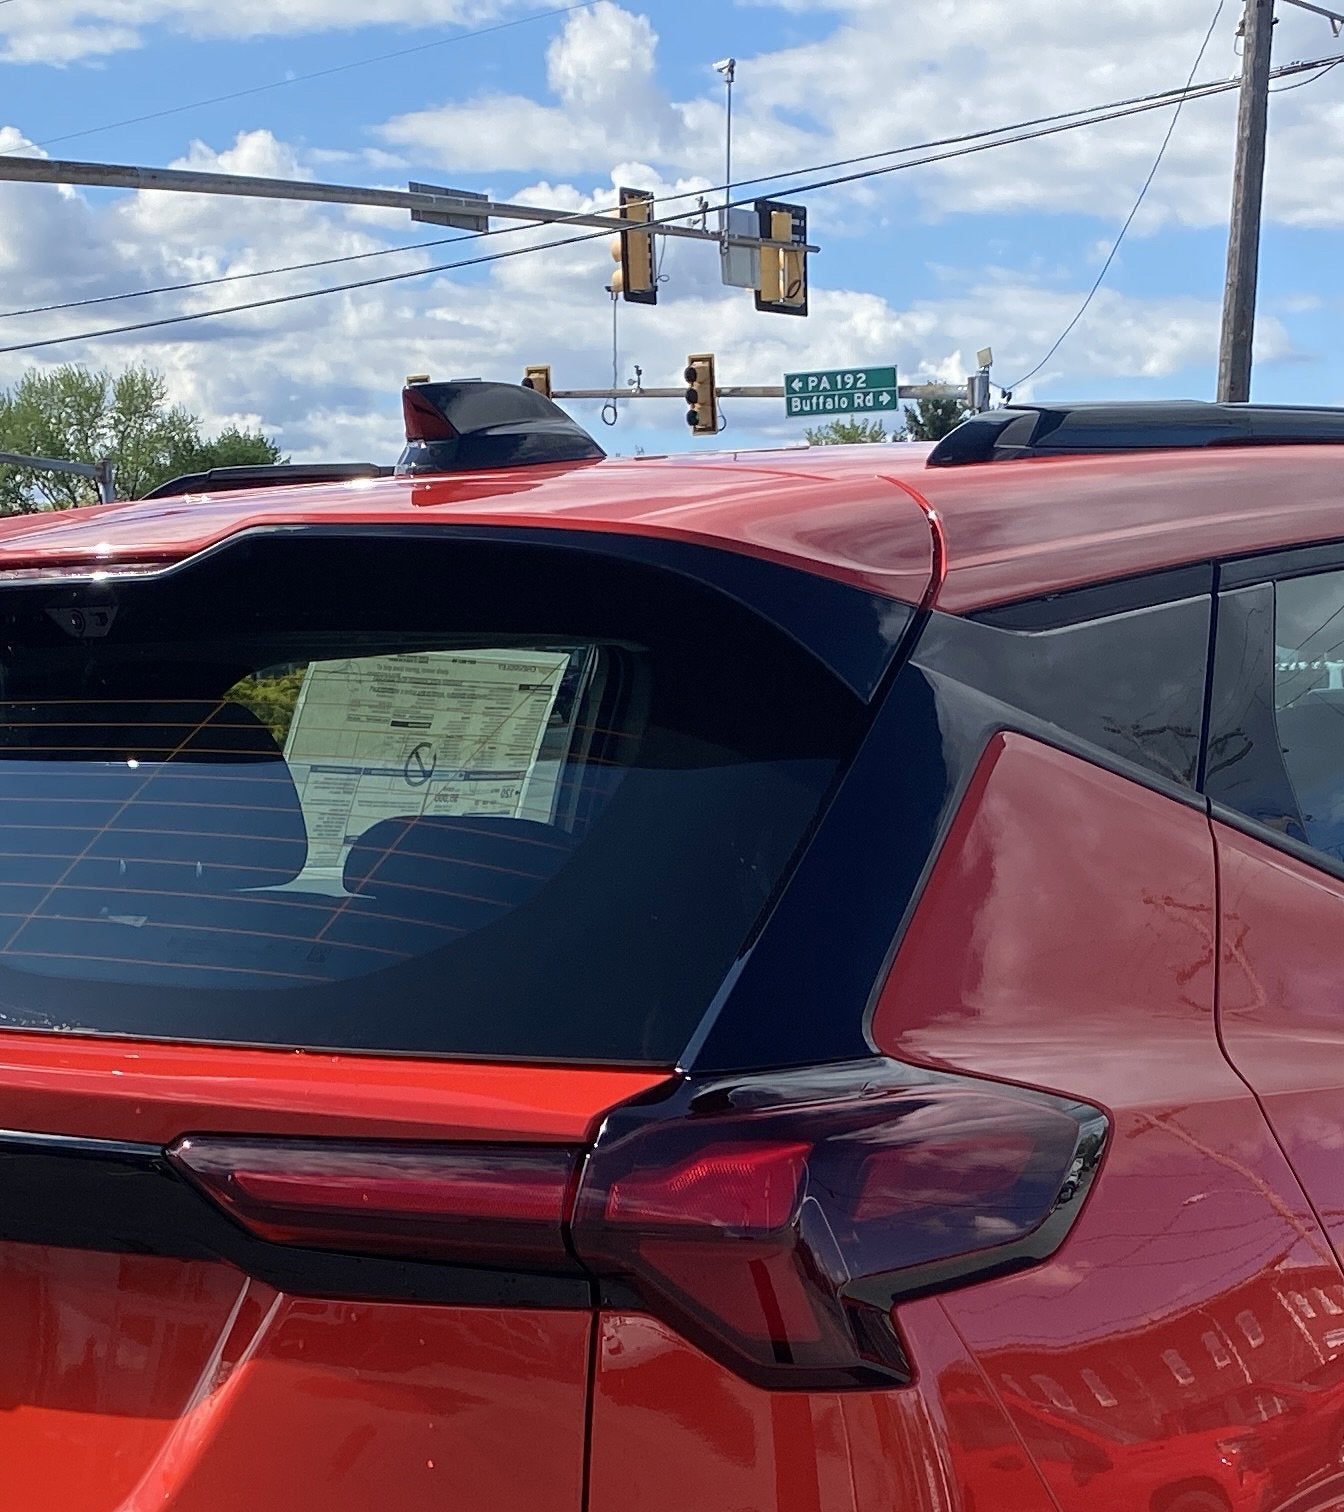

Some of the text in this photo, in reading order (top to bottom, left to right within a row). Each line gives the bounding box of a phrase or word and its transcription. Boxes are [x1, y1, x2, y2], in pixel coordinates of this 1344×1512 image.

[807, 372, 867, 392] PA 192
[791, 391, 874, 413] Buffalo Rd
